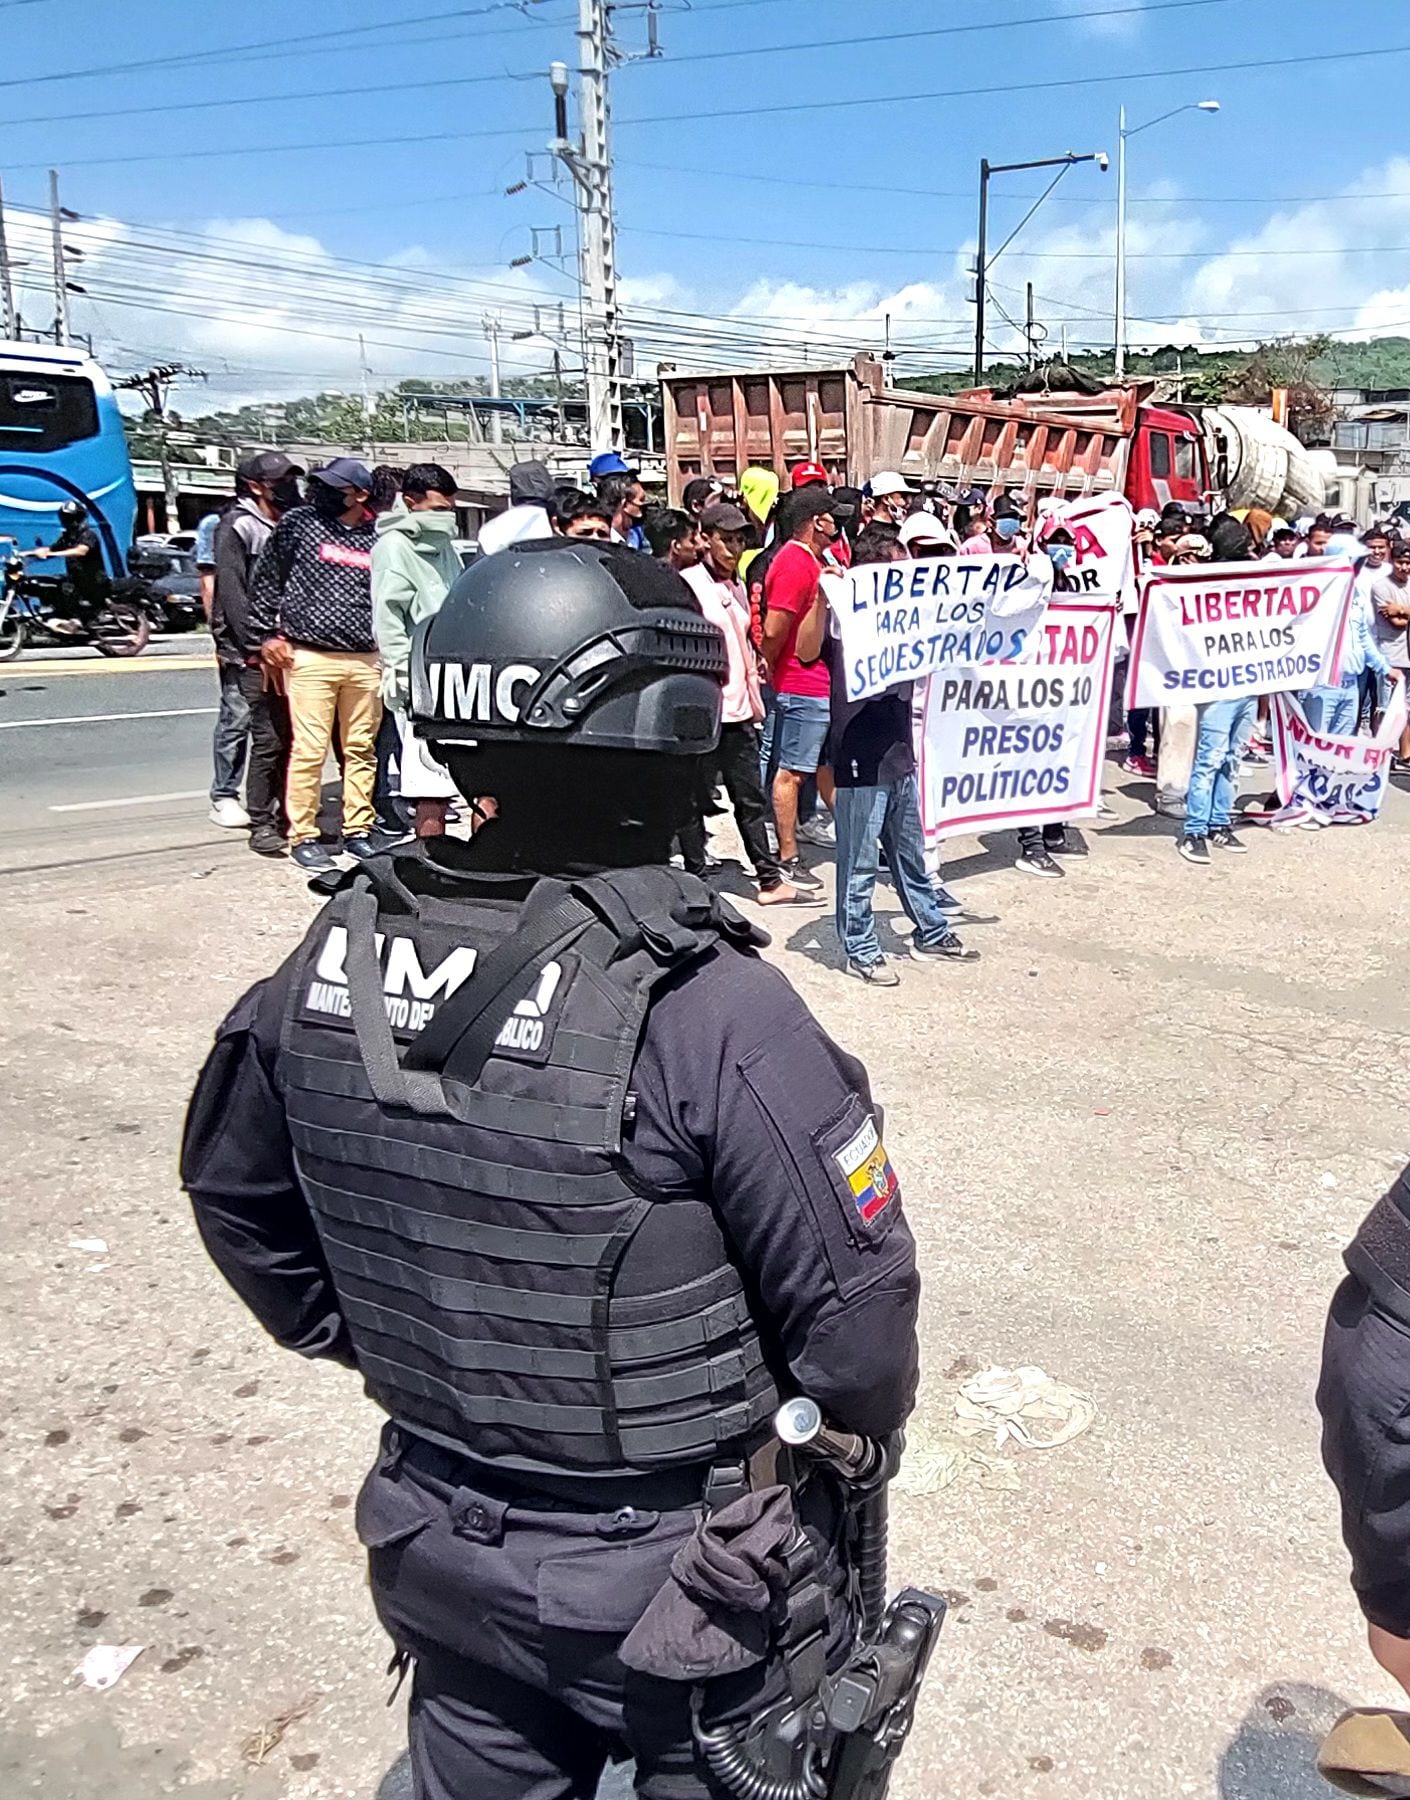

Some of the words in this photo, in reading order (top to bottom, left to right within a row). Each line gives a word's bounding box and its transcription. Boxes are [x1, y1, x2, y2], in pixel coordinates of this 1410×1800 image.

[851, 563, 1029, 613] LIBERTAD
[1179, 586, 1321, 626] LIBERTAD
[936, 602, 985, 623] LOS
[1204, 630, 1258, 657] PARA
[1259, 625, 1296, 649] LOS
[1163, 653, 1321, 690] SECUESTRADOS
[940, 679, 1010, 712] PARA
[1017, 677, 1065, 709] LOS
[1069, 676, 1092, 706] 10
[962, 723, 1065, 758] PRESOS
[941, 762, 1071, 808] POLÍTICOS
